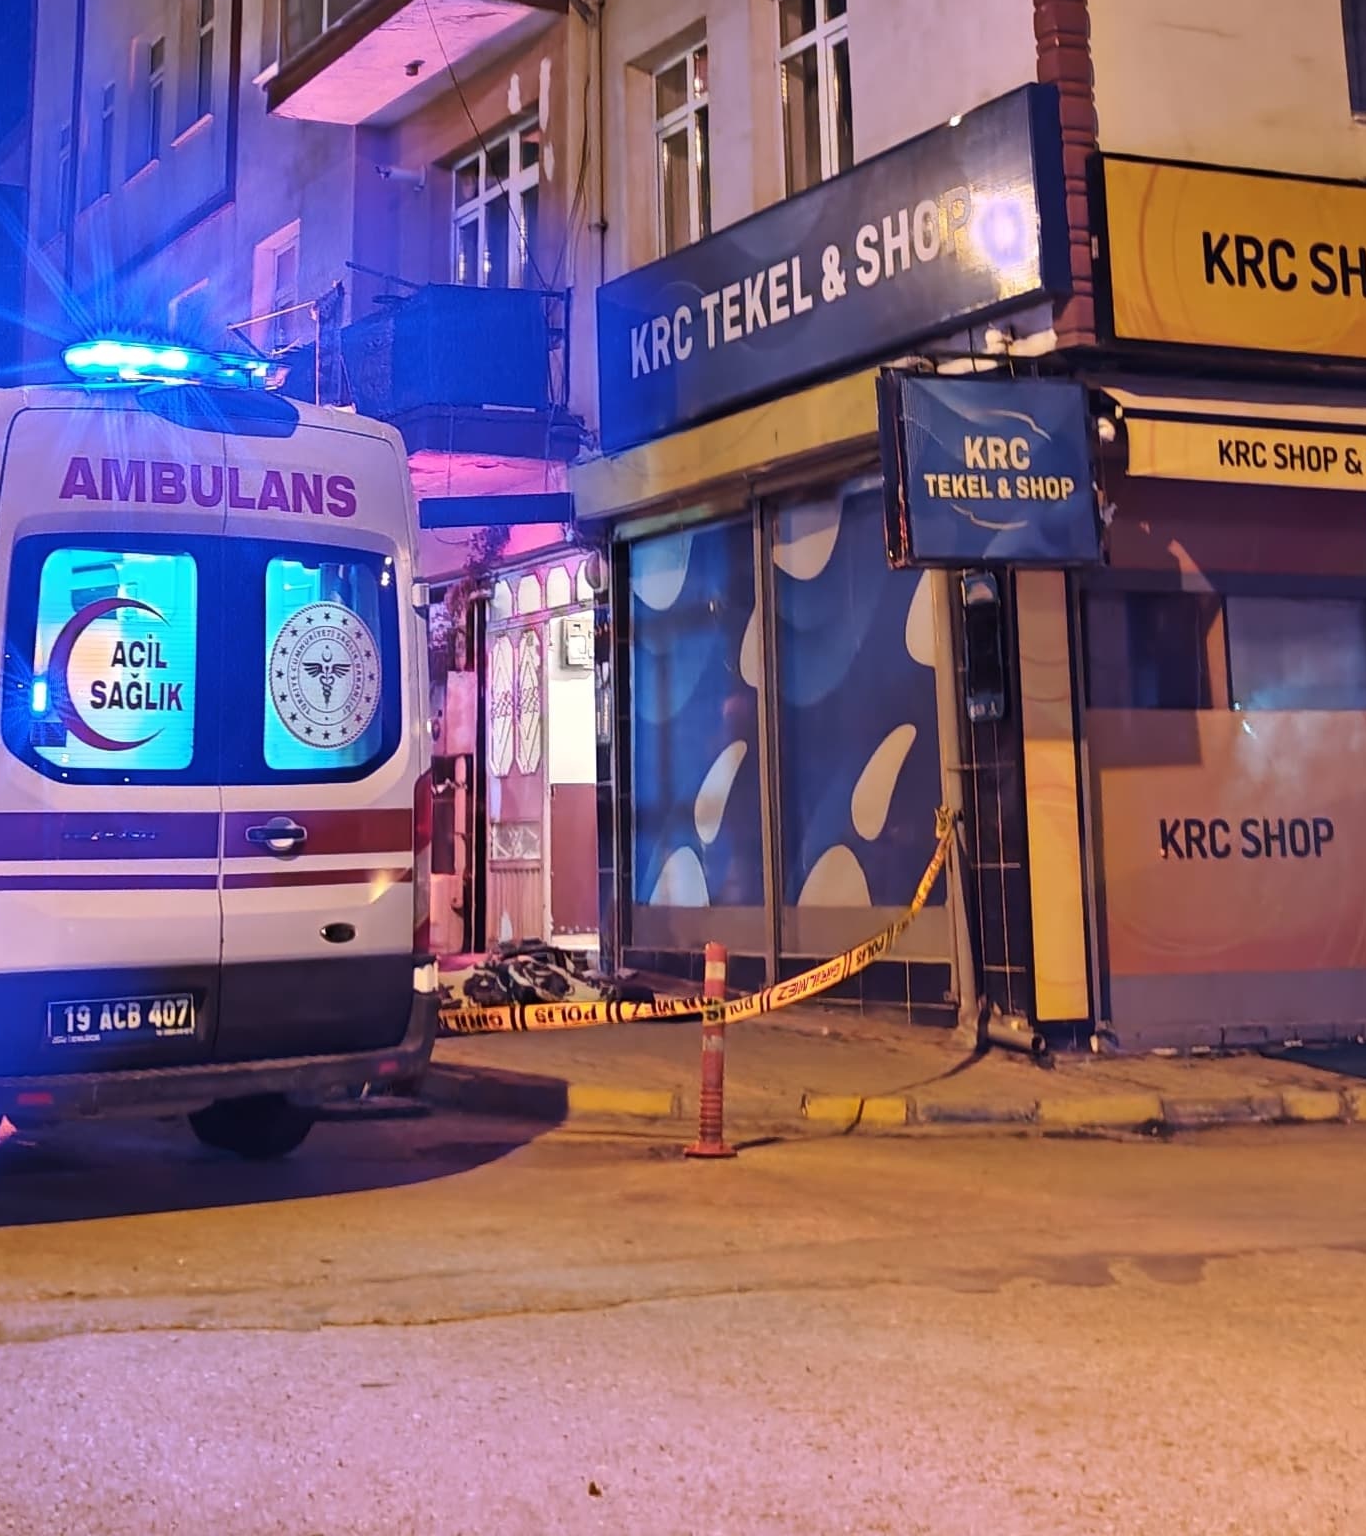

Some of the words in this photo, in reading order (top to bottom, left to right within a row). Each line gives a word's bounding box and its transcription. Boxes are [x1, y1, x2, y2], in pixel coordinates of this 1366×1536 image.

[1202, 230, 1298, 292] KRC
[630, 305, 693, 378] KRC
[701, 256, 813, 350] TEKEL
[822, 244, 847, 303] &
[855, 185, 972, 289] SHOP
[964, 435, 1031, 471] KRC
[1218, 438, 1268, 469] KRC
[1273, 442, 1338, 473] SHOP
[1344, 447, 1364, 475] &
[58, 456, 357, 518] AMBULANS
[923, 473, 994, 500] TEKEL
[997, 476, 1012, 500] &
[1016, 475, 1075, 501] SHOP
[111, 633, 168, 669] ACİL
[90, 672, 183, 711] SAĞLIK
[1159, 817, 1232, 860] KRC
[1240, 816, 1335, 859] SHOP
[64, 1005, 91, 1032] 19
[100, 1002, 142, 1031] ACB
[148, 998, 189, 1028] 407
